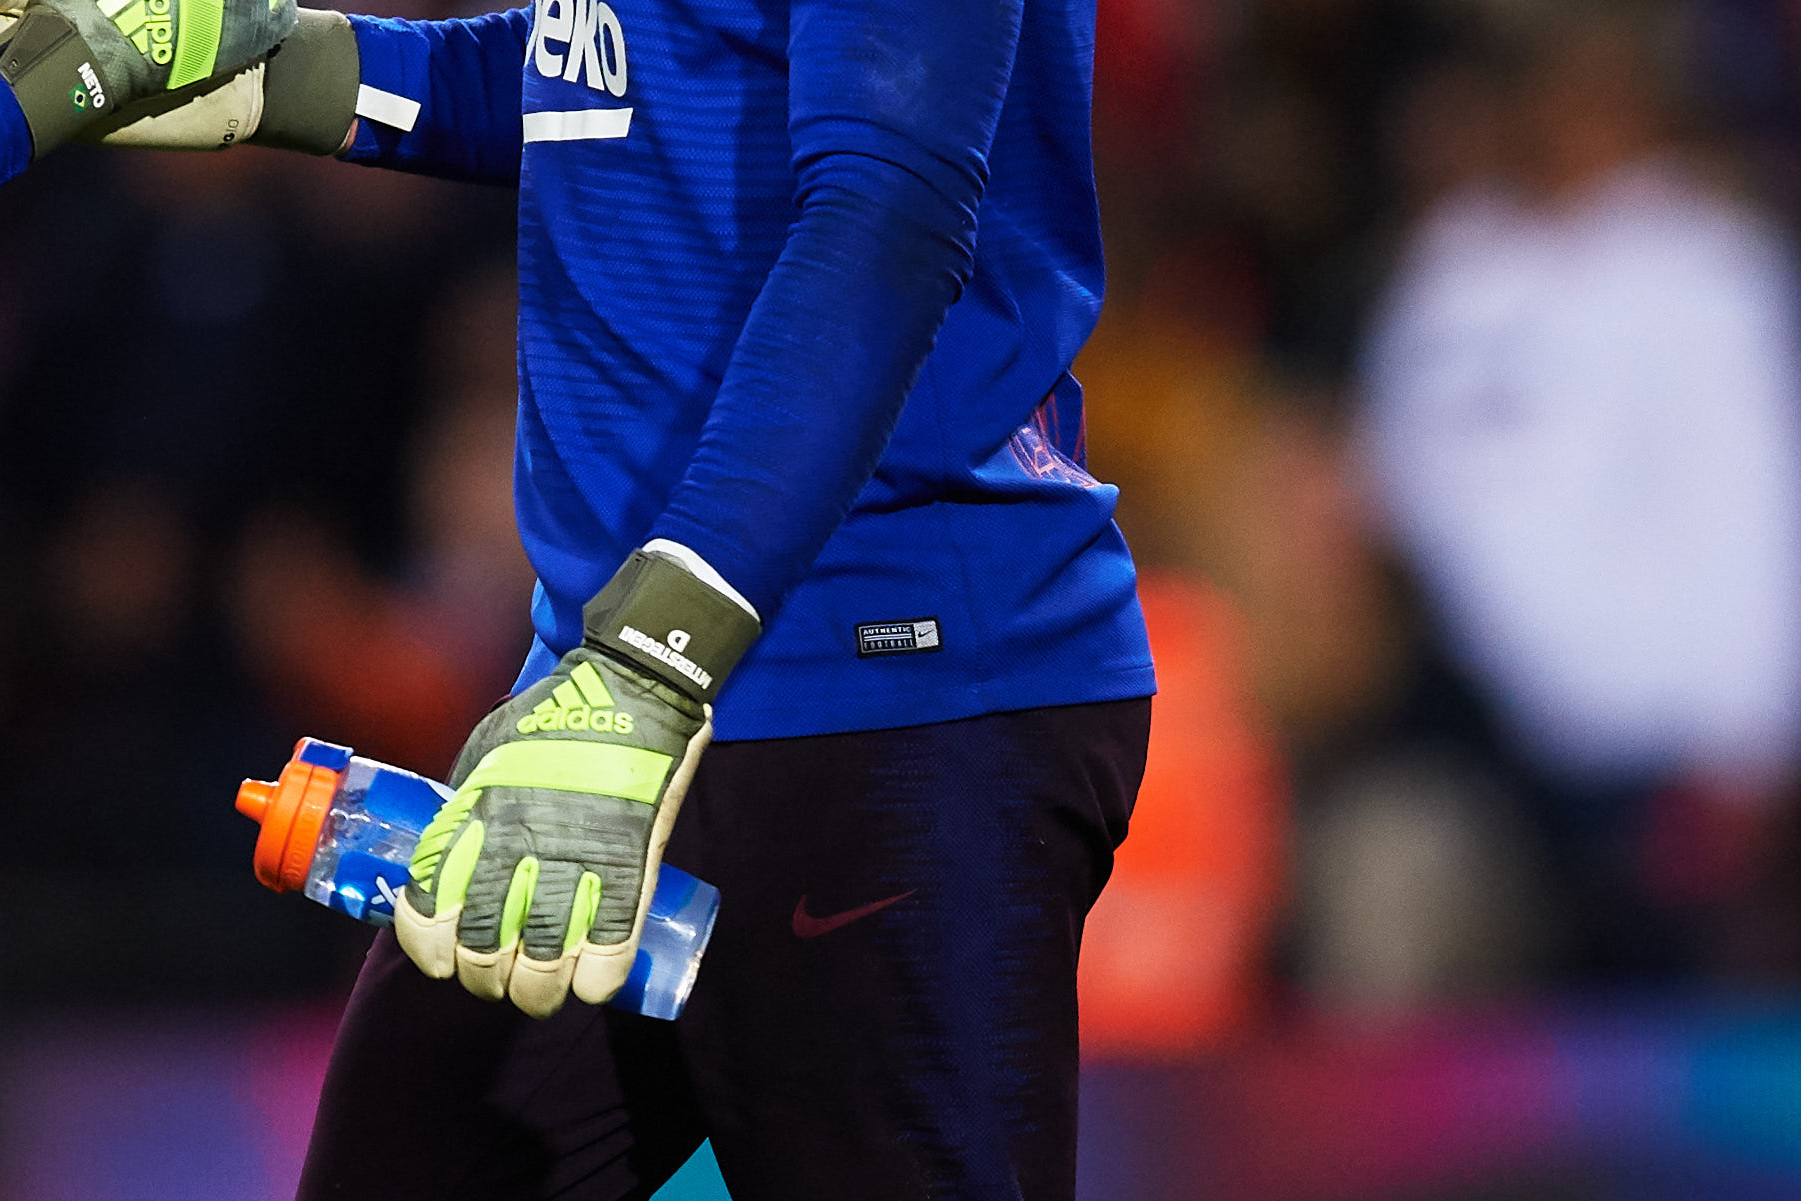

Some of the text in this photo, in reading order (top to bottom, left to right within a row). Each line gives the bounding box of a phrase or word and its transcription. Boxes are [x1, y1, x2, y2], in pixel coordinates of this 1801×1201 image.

[77, 61, 105, 108] NETO
[863, 626, 912, 636] AUTHENTIC
[864, 638, 914, 650] FOOTBALL
[516, 704, 634, 735] adidas
